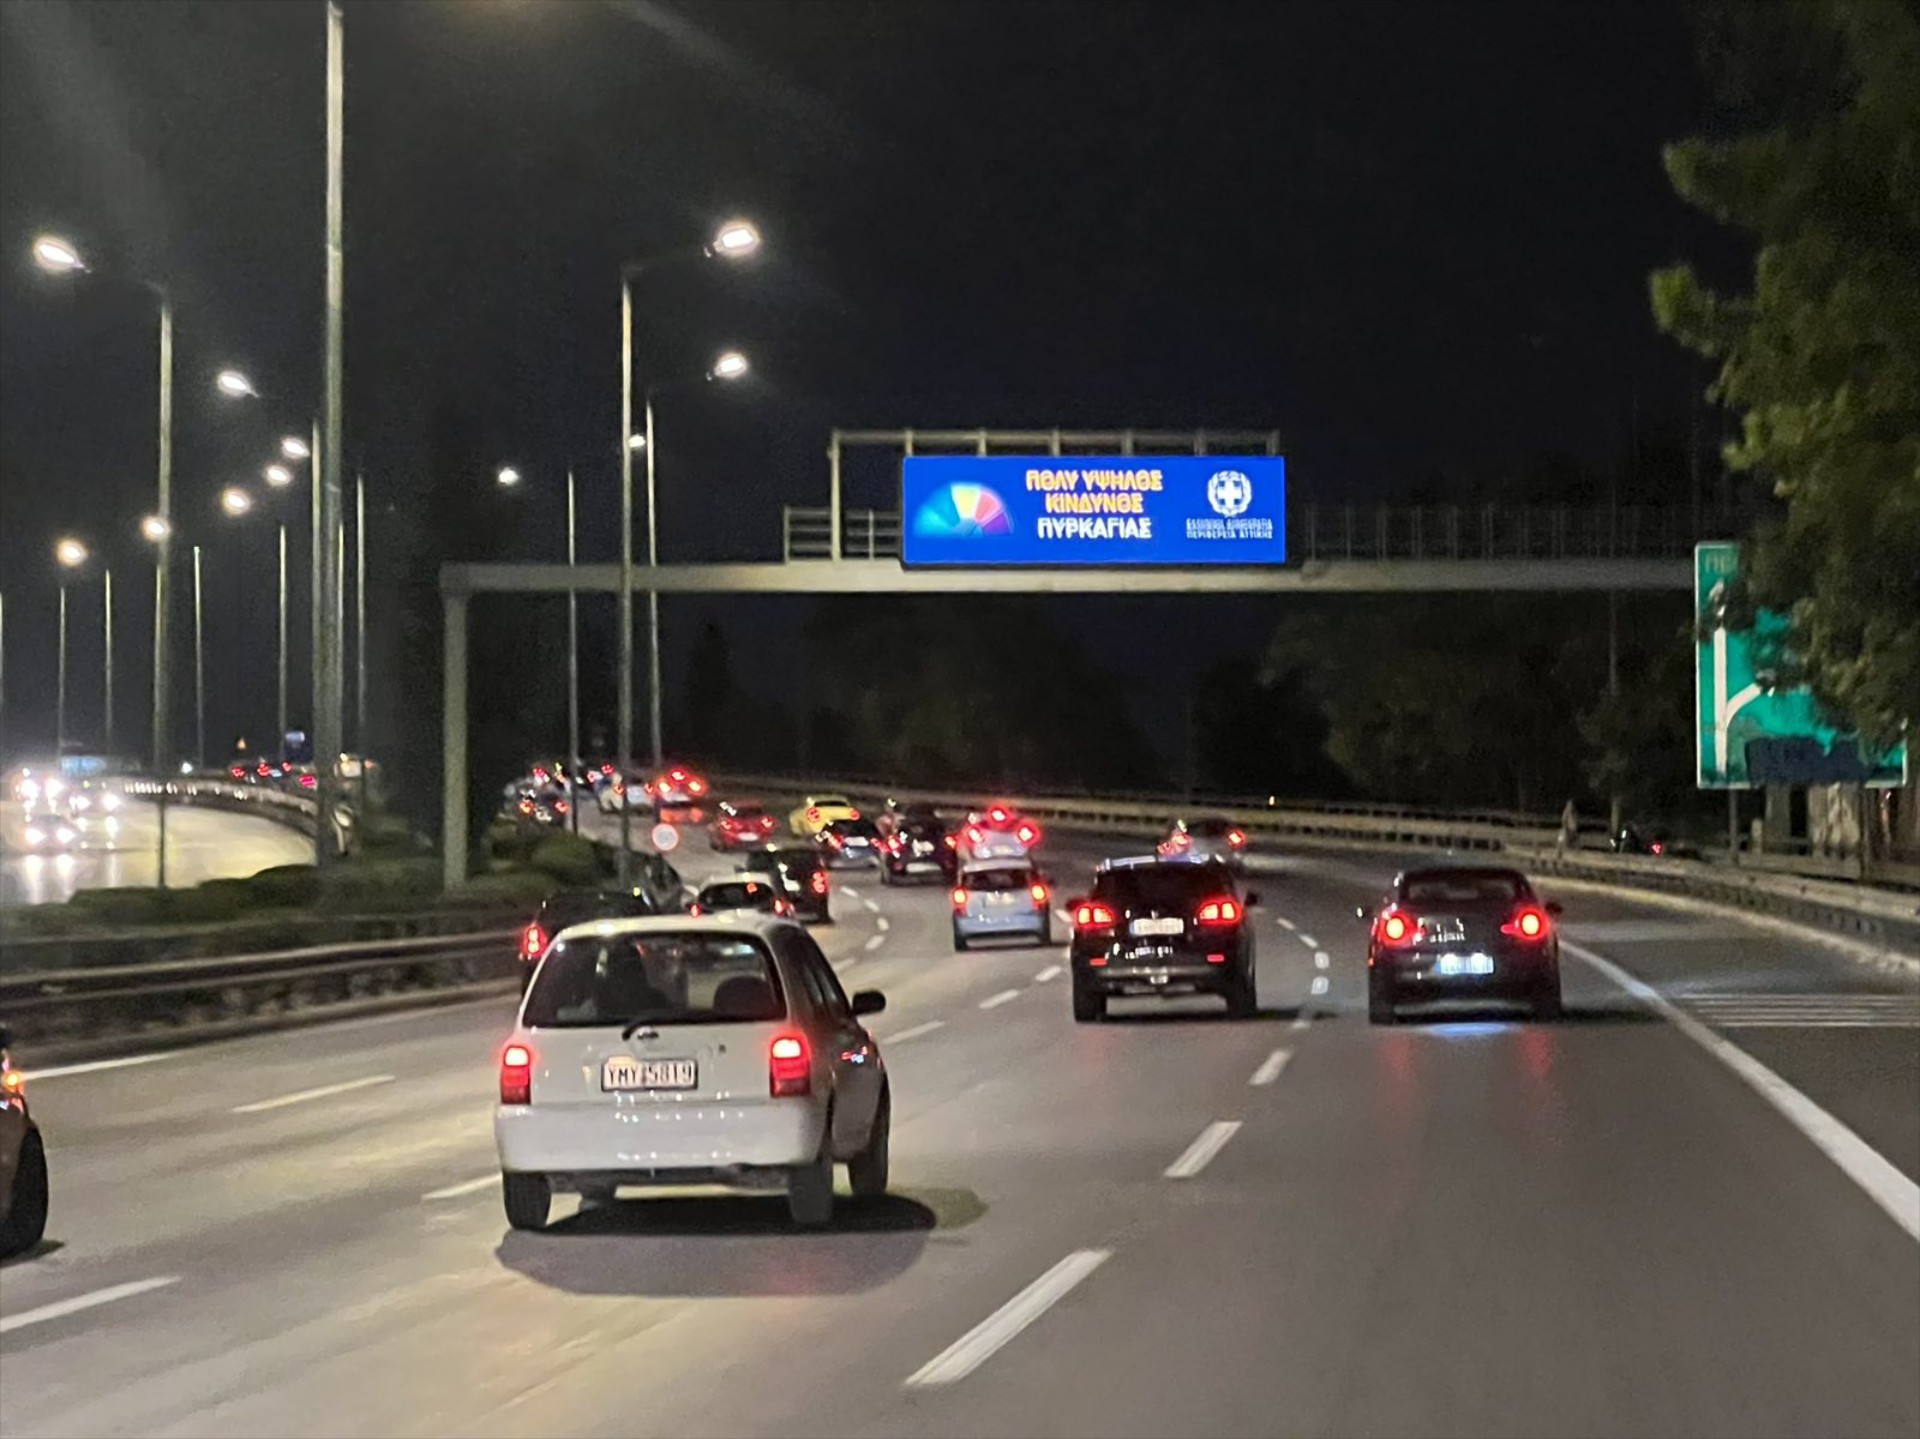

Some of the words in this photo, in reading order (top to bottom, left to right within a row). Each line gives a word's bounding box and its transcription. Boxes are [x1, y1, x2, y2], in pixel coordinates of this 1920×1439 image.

[1025, 469, 1079, 491] ΠΟΛΥ
[1081, 469, 1163, 491] ΥΨΗΛΟΣ
[1045, 492, 1144, 513] ΚΙΝΔΥΝΟΣ
[1037, 517, 1152, 539] ΠΥΡΚΑΓΙΑΣ
